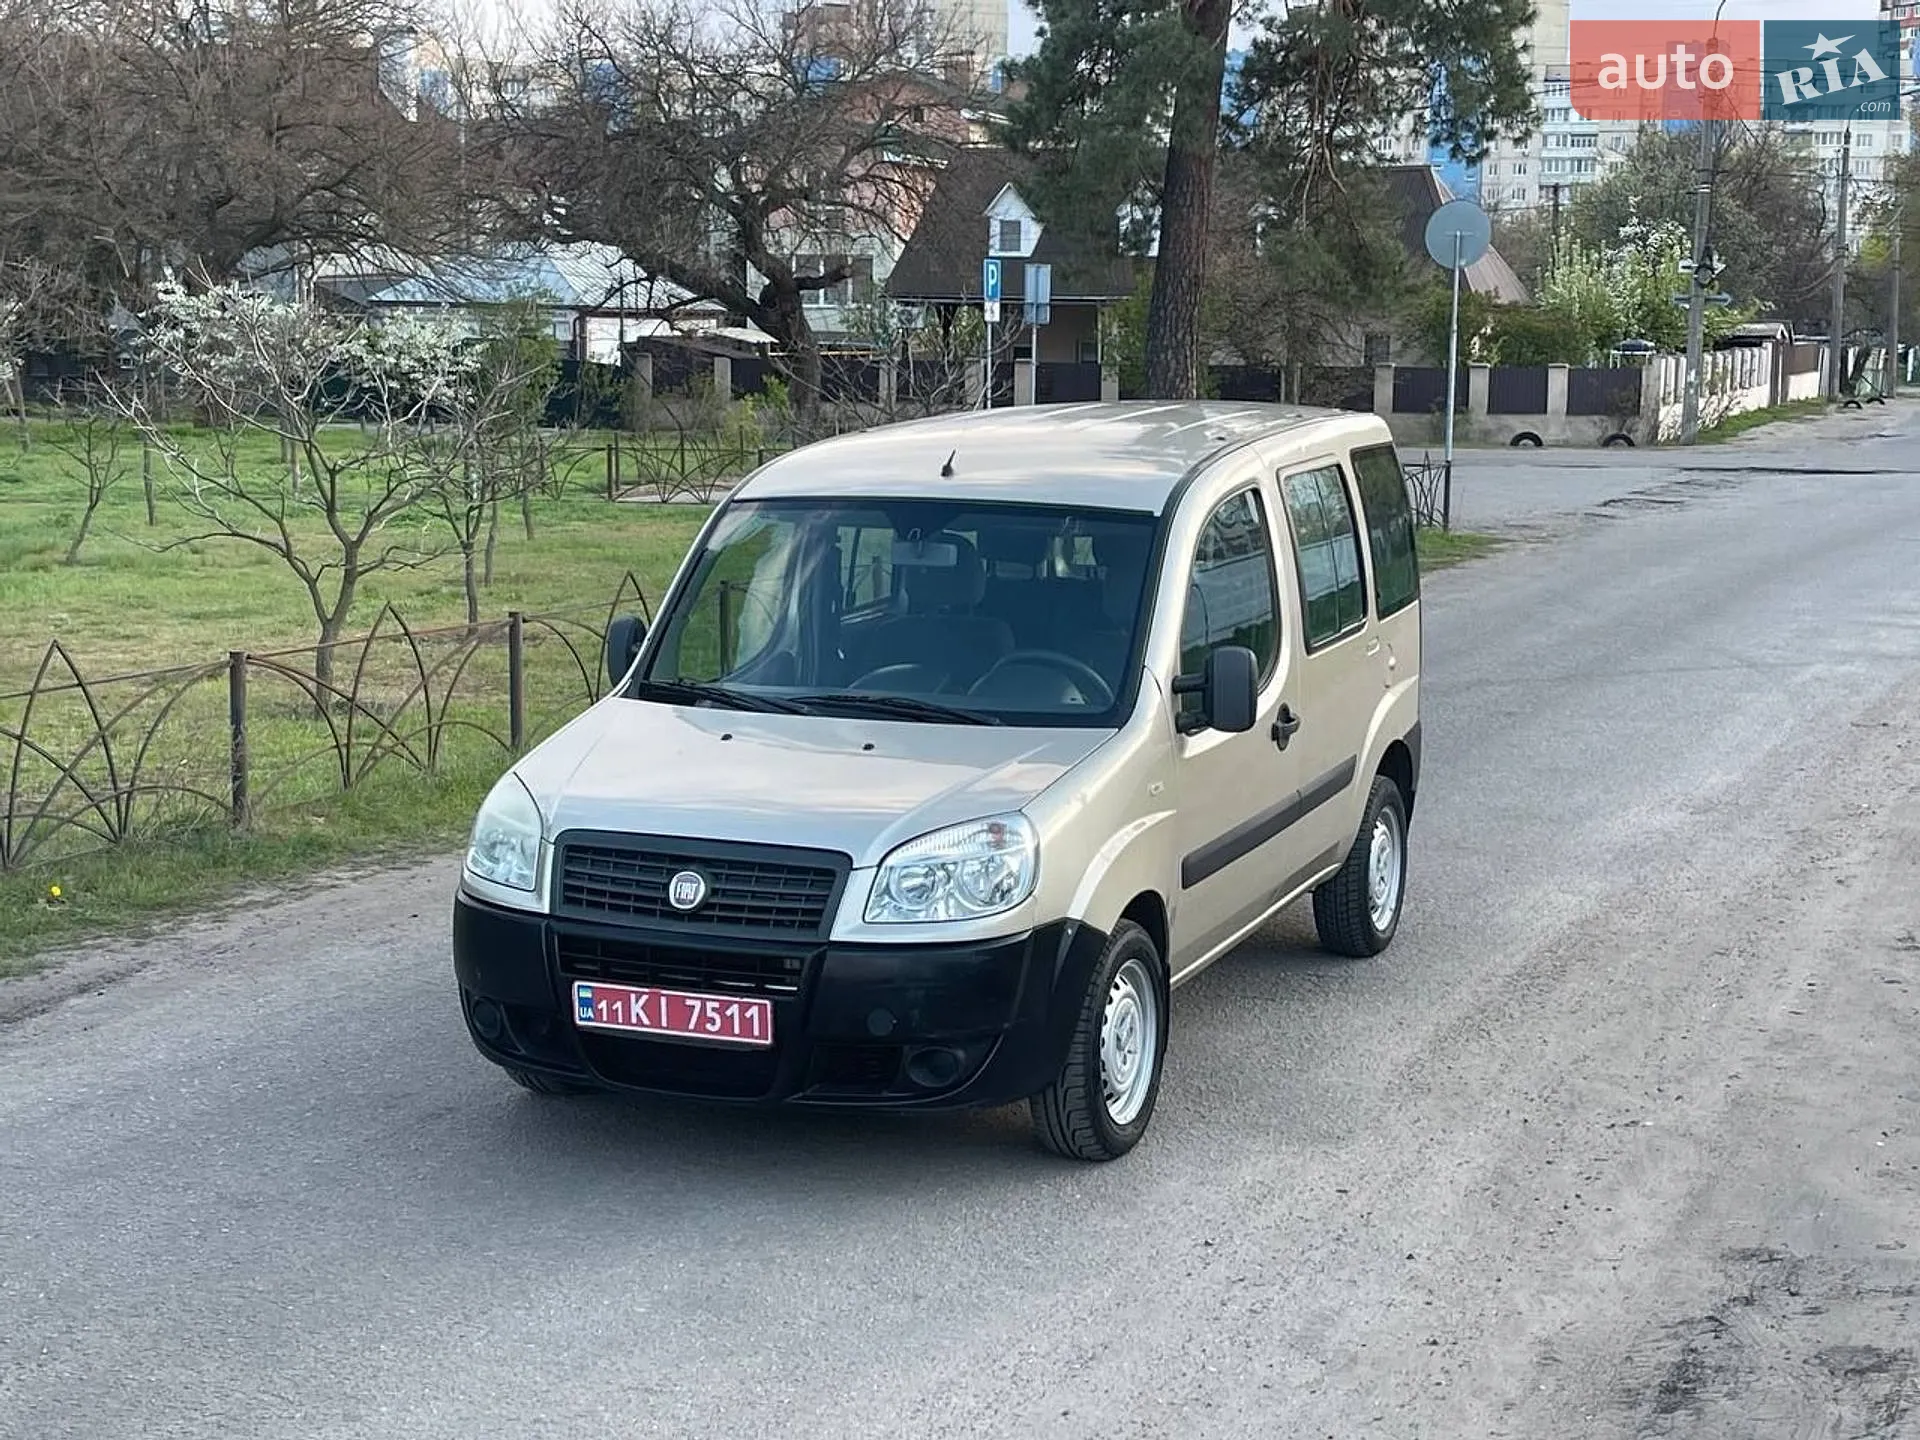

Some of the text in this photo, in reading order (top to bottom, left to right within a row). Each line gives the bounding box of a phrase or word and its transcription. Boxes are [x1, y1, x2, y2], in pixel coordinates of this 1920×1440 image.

[988, 264, 998, 297] P
[676, 881, 698, 900] FIAT
[580, 1007, 595, 1019] UA
[685, 998, 760, 1037] 7511
